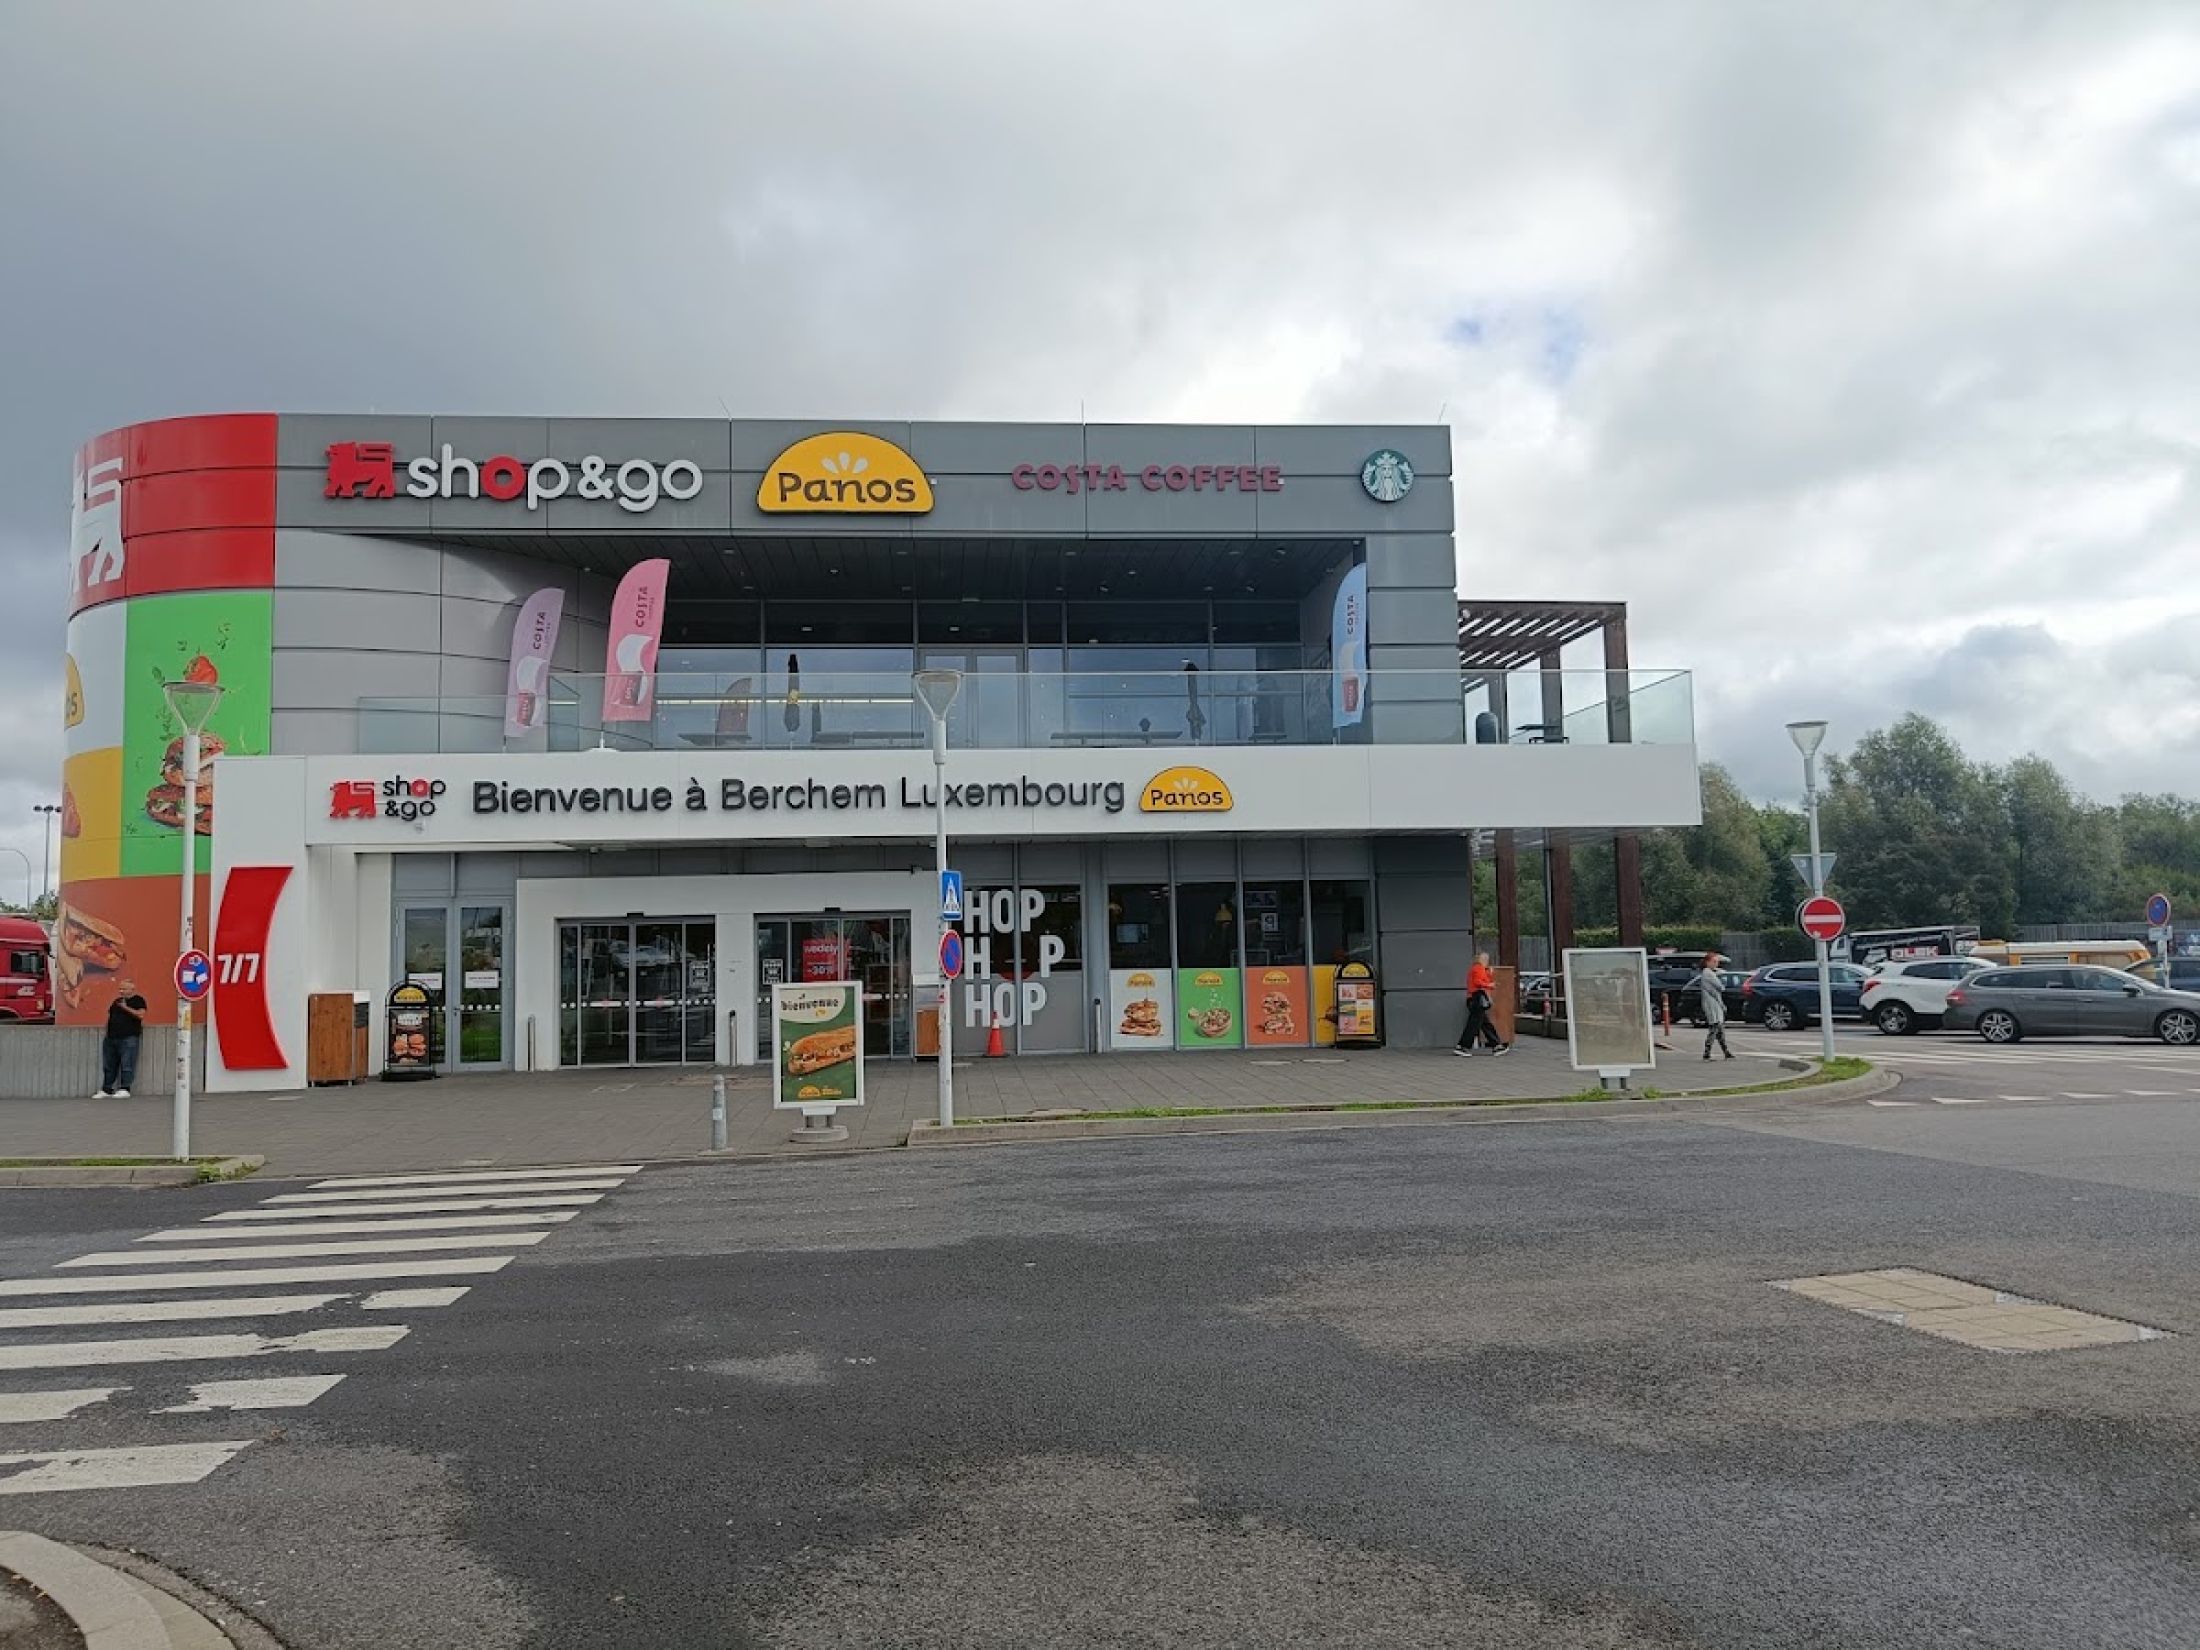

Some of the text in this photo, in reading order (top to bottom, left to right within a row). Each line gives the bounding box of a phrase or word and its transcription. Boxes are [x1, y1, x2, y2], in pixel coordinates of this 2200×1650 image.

[407, 443, 703, 512] shop&go
[778, 472, 916, 503] Panos
[1012, 463, 1282, 494] COSTA COFFEE
[635, 586, 648, 628] COSTA
[533, 611, 547, 650] COSTA
[383, 775, 447, 803] shop
[472, 775, 1125, 814] Bienvenue à Berchem Luxembourg
[1150, 789, 1223, 806] Panos
[384, 801, 437, 821] &go
[964, 889, 1046, 933] HOP
[217, 952, 260, 985] 7/7
[966, 982, 1047, 1027] HOP
